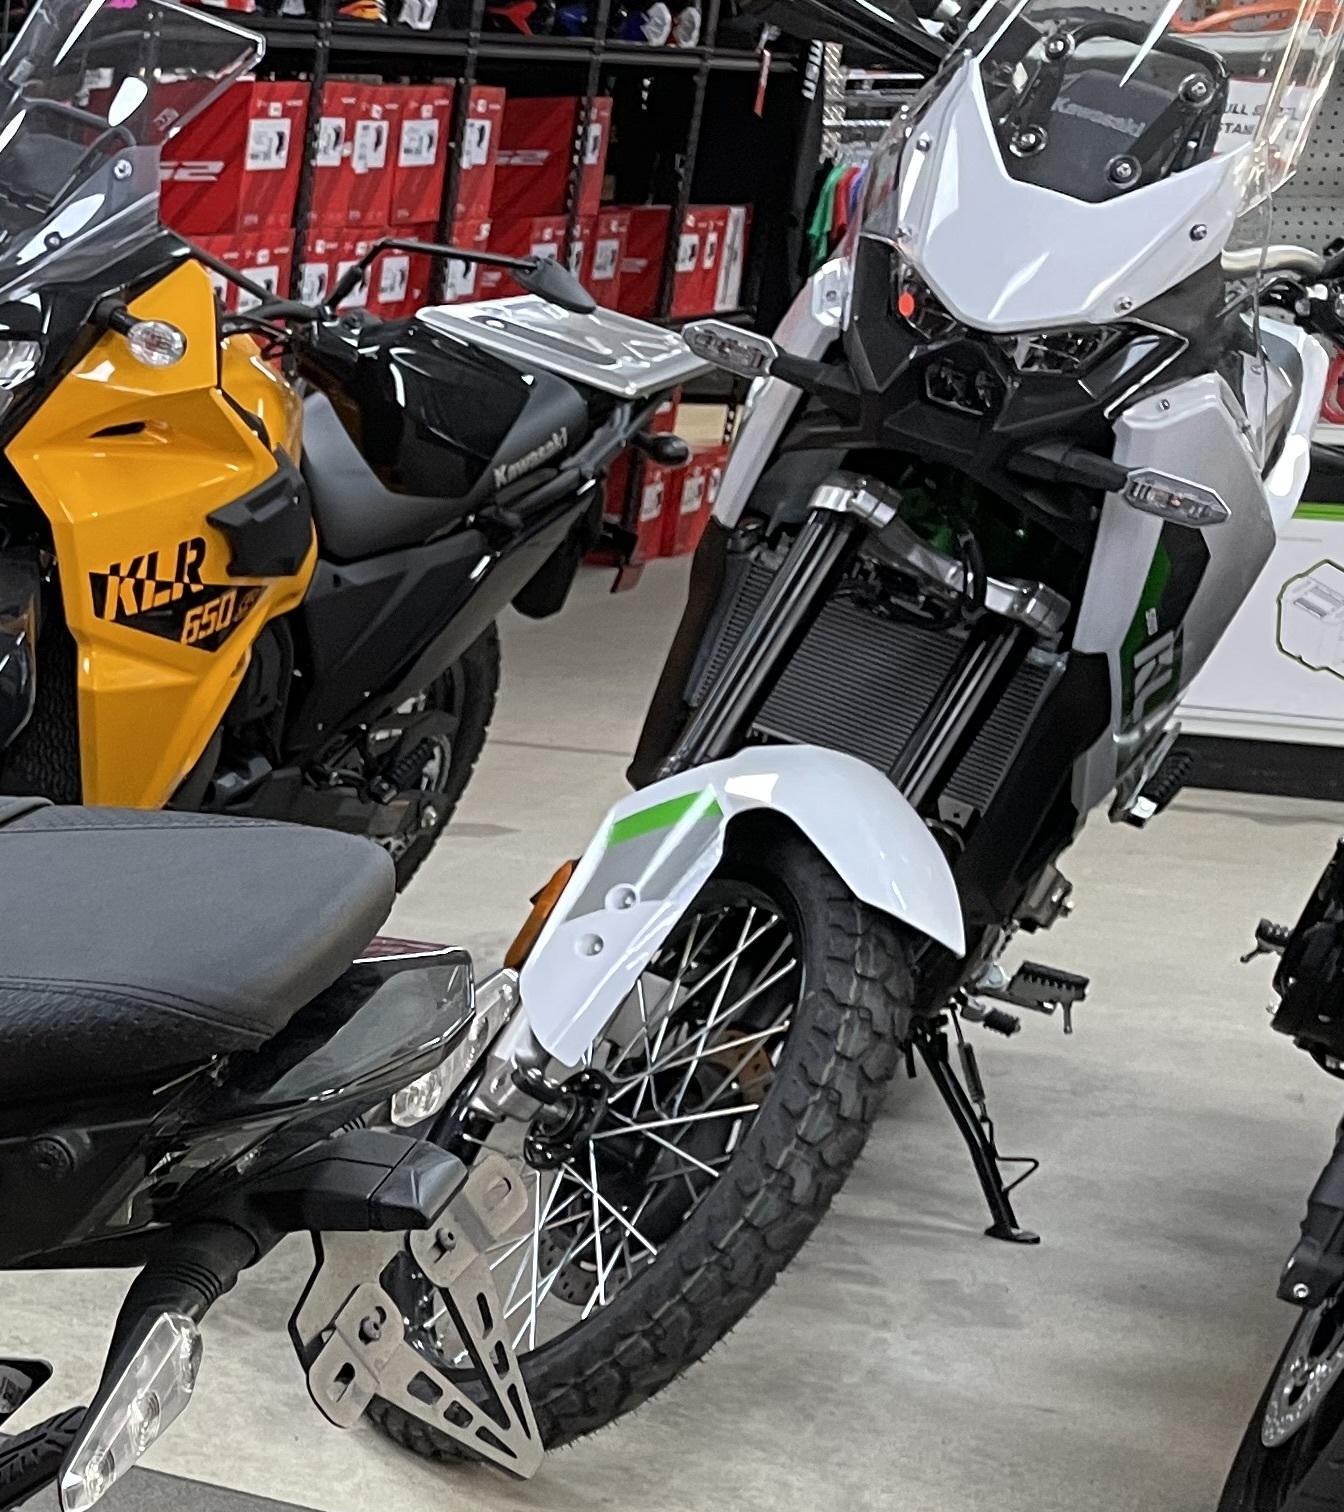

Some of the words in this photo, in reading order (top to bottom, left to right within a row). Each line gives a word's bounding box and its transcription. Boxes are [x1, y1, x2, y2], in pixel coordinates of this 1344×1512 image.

[1051, 97, 1146, 138] Kawasaki
[494, 427, 568, 489] Kawasaki
[104, 536, 206, 622] KLR
[180, 589, 238, 645] 650
